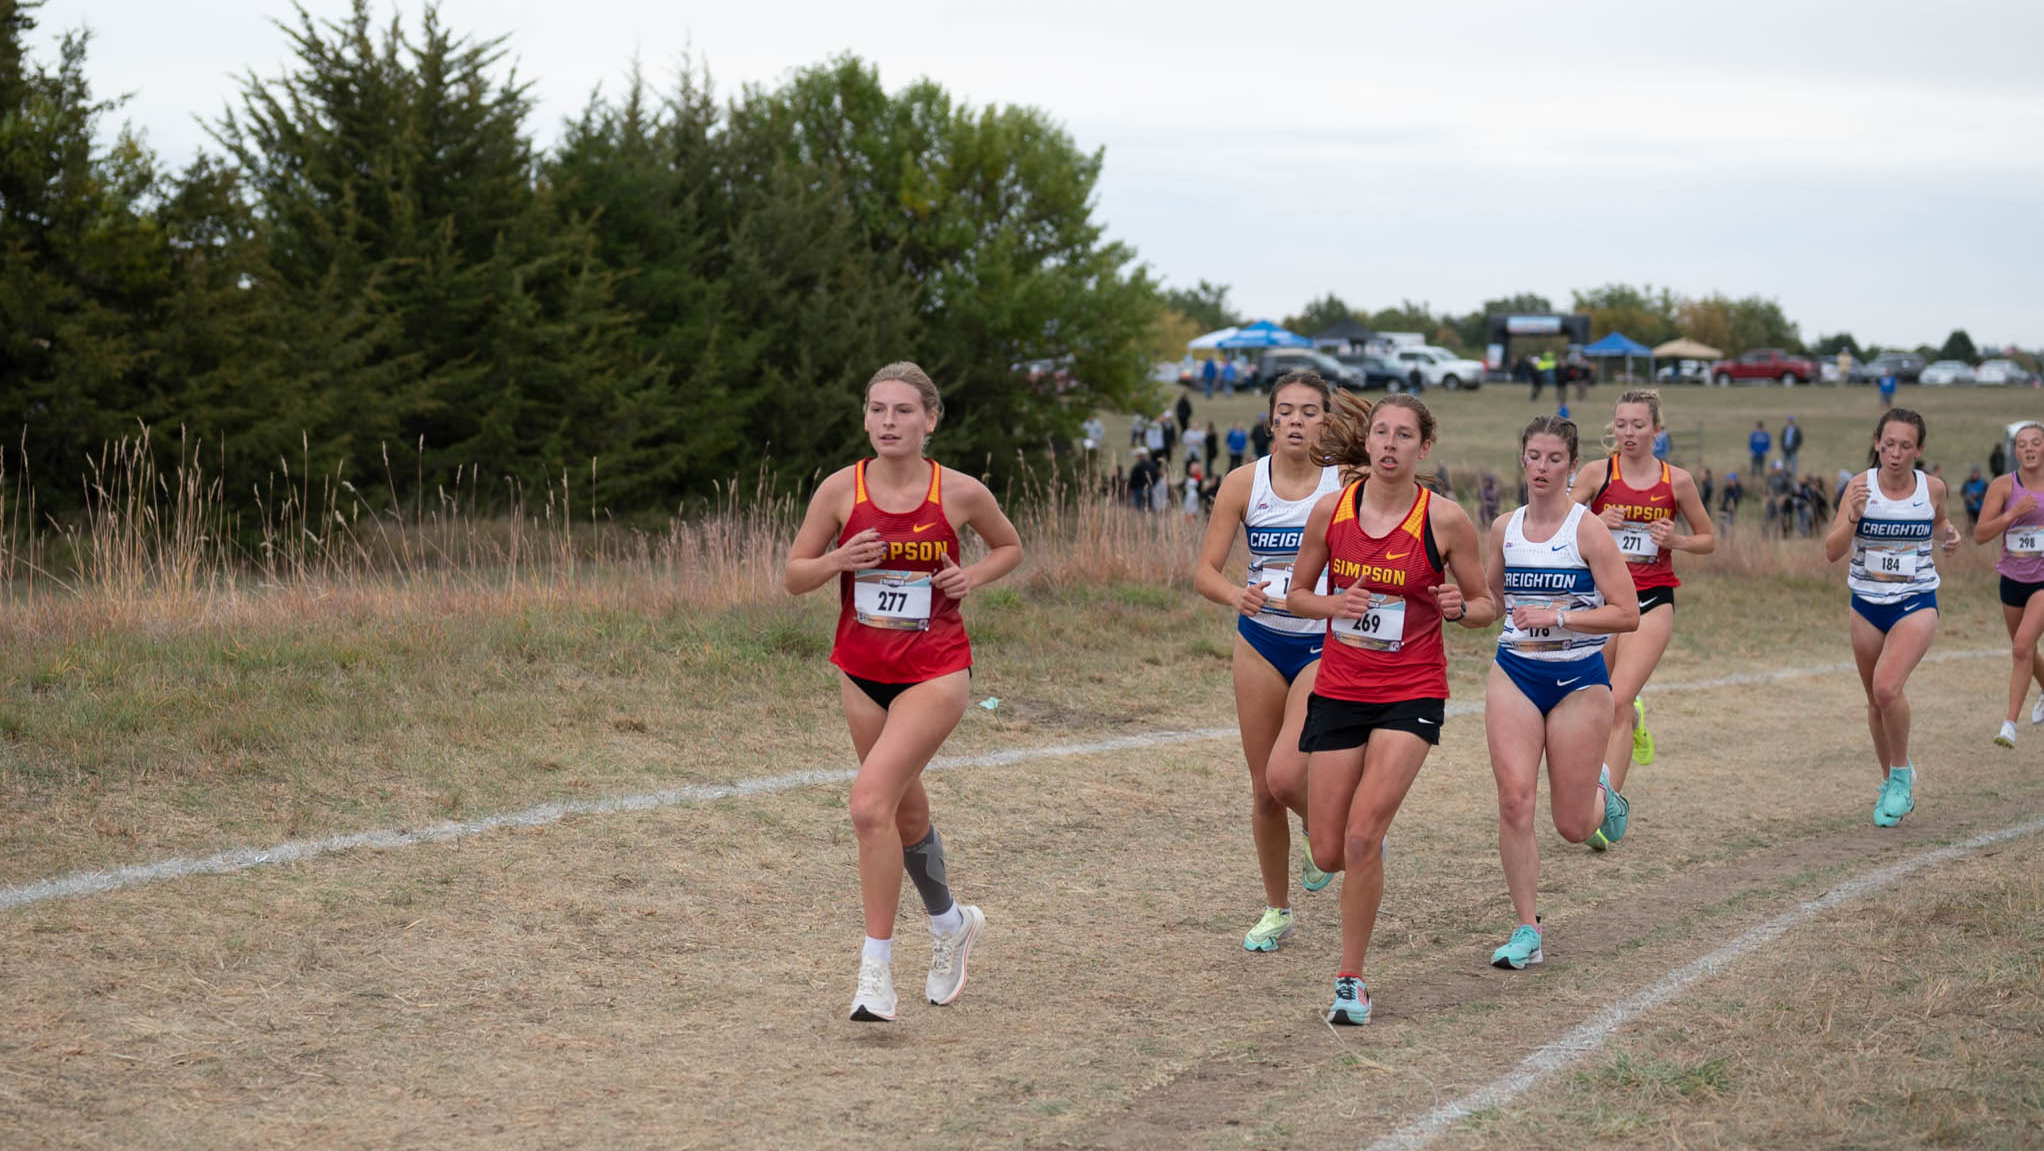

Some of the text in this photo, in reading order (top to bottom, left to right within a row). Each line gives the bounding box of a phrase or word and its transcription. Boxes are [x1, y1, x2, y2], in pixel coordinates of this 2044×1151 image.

[1862, 522, 1931, 536] CREIGHTON
[881, 541, 948, 561] PSON
[1622, 536, 1642, 551] 271
[2019, 537, 2035, 549] 298
[1332, 558, 1406, 586] SIMPSON
[1881, 557, 1900, 572] 184
[1503, 572, 1577, 589] REIGHTON
[877, 591, 908, 612] 277
